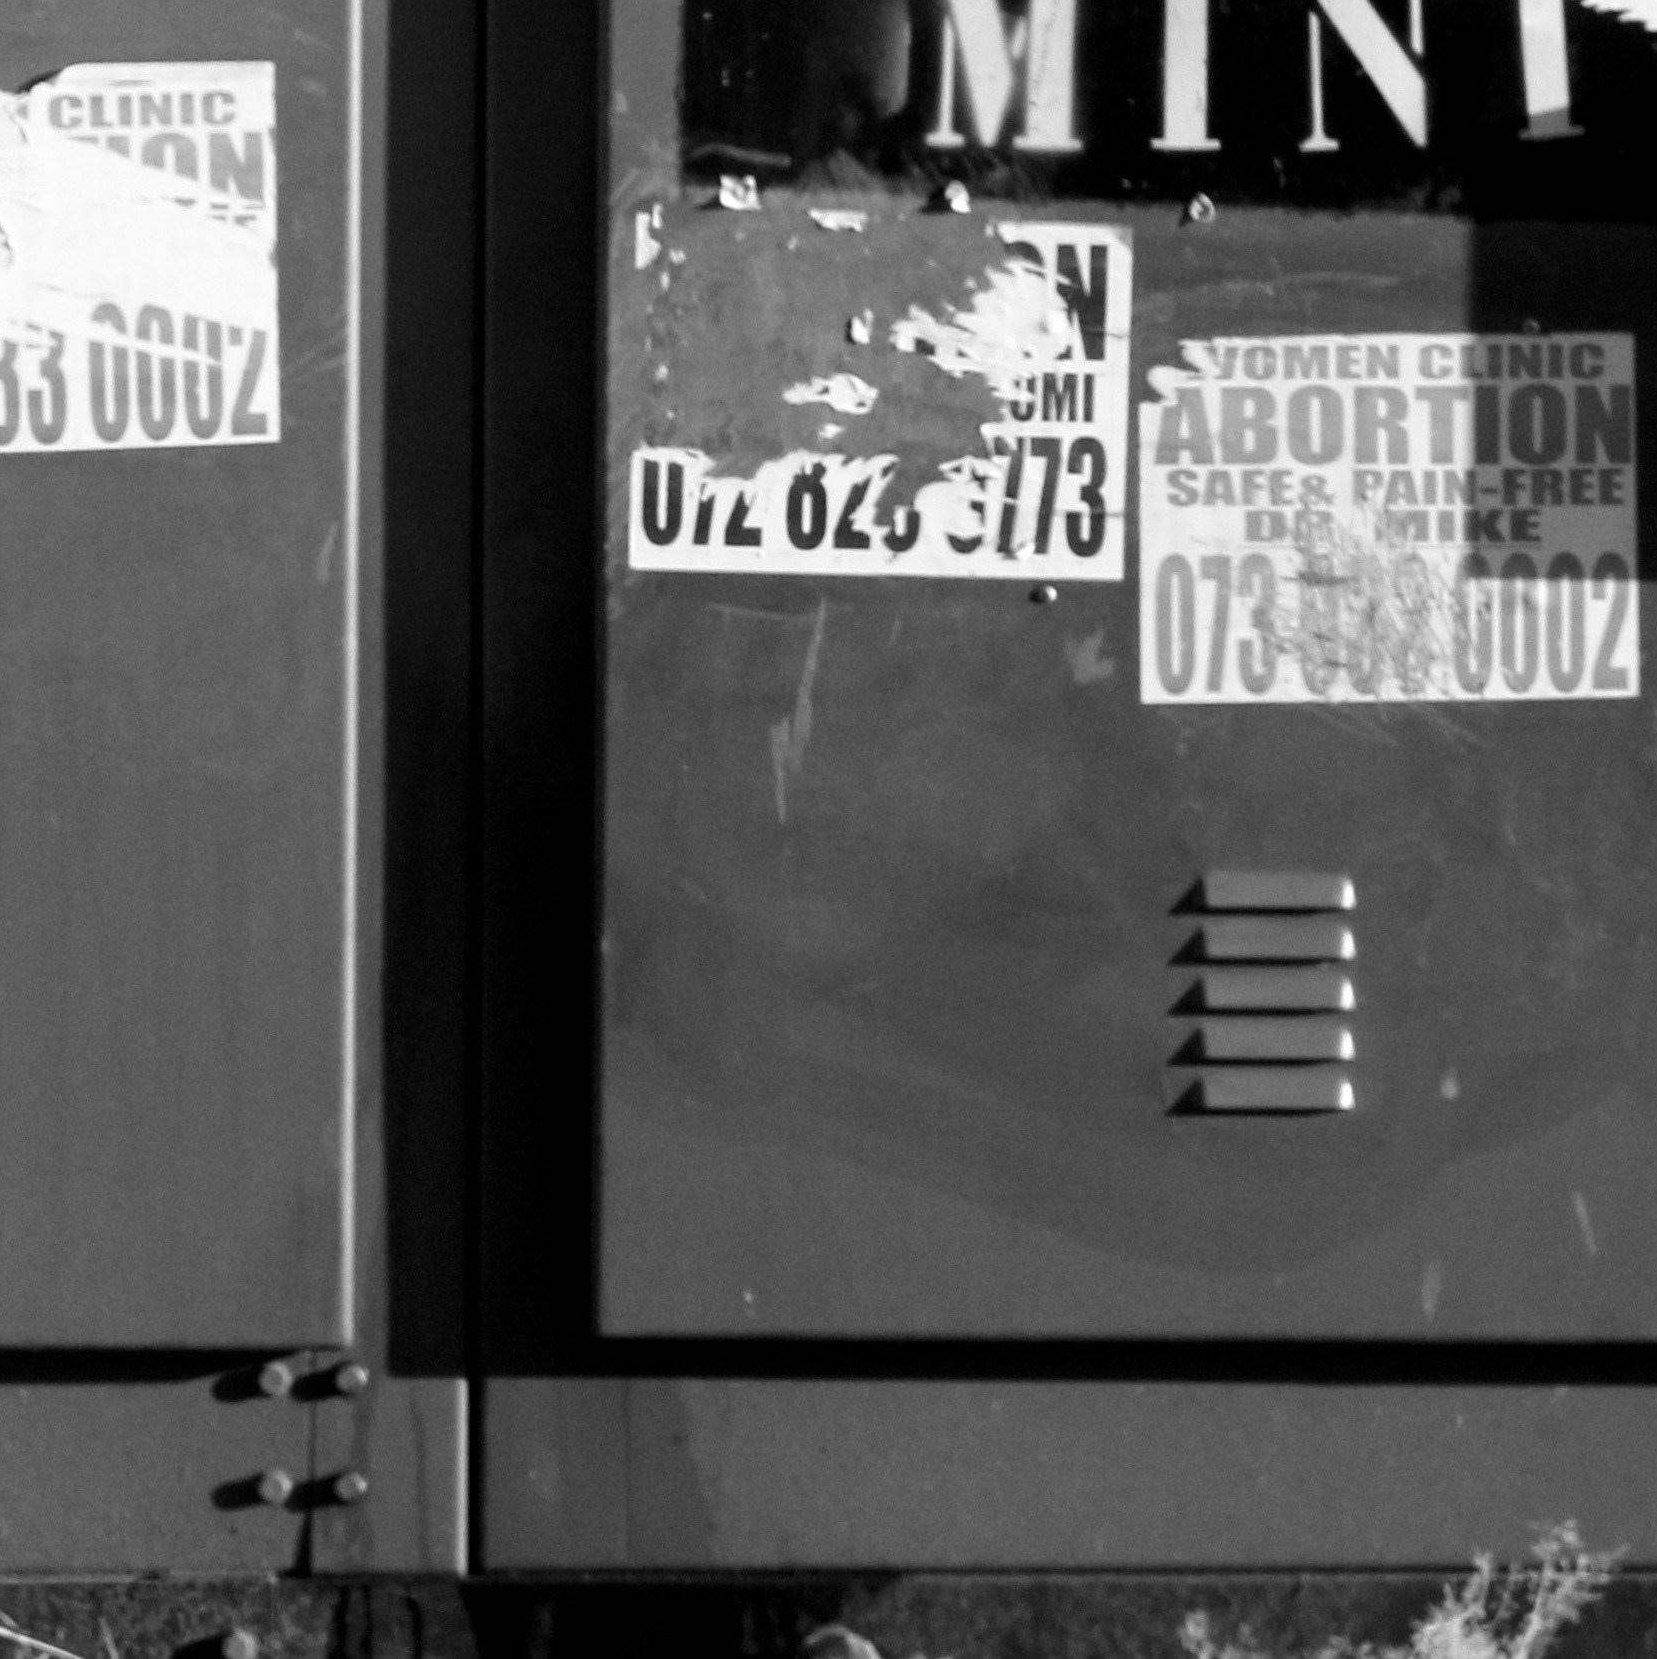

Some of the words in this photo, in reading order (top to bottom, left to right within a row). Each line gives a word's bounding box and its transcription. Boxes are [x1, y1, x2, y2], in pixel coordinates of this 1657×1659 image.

[48, 89, 236, 130] CLINIC
[1417, 342, 1606, 381] CLINIC
[1153, 383, 1632, 466] ABORTION
[1166, 468, 1336, 508] SAFE&
[1352, 468, 1625, 507] PAIN-FREE
[1155, 550, 1278, 695] 073
[1452, 550, 1630, 694] 0002
